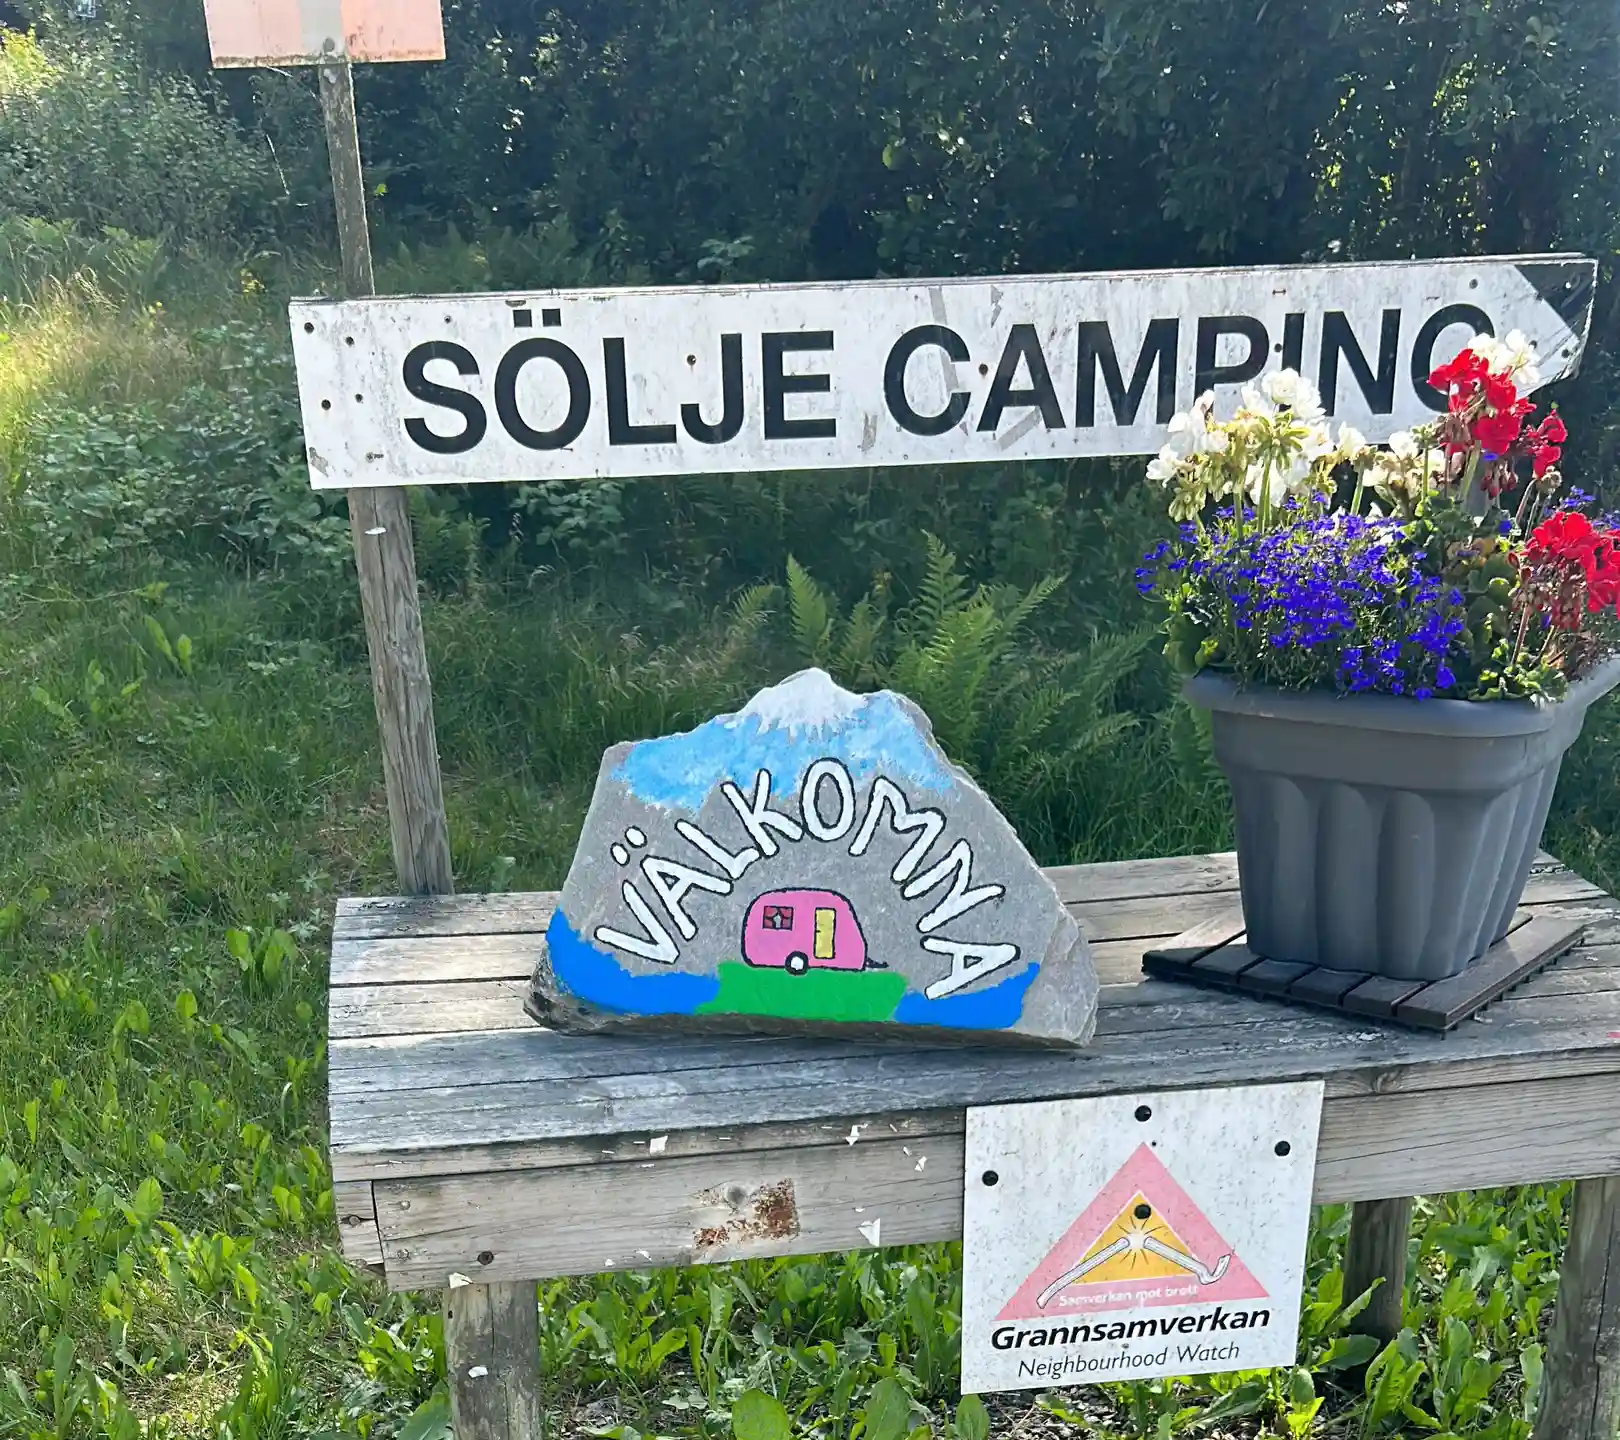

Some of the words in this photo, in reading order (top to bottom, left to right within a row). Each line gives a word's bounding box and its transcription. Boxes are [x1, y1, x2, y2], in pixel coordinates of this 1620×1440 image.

[402, 308, 837, 455] SÖLJE
[594, 757, 1021, 1000] VÄLKOMNA
[1058, 1290, 1132, 1307] Samverkan
[1135, 1286, 1162, 1300] mot
[1165, 1284, 1199, 1297] brott
[991, 1307, 1270, 1350] Grannsamverkan
[1018, 1347, 1168, 1380] Neighbourhood
[1176, 1341, 1240, 1363] Watch
